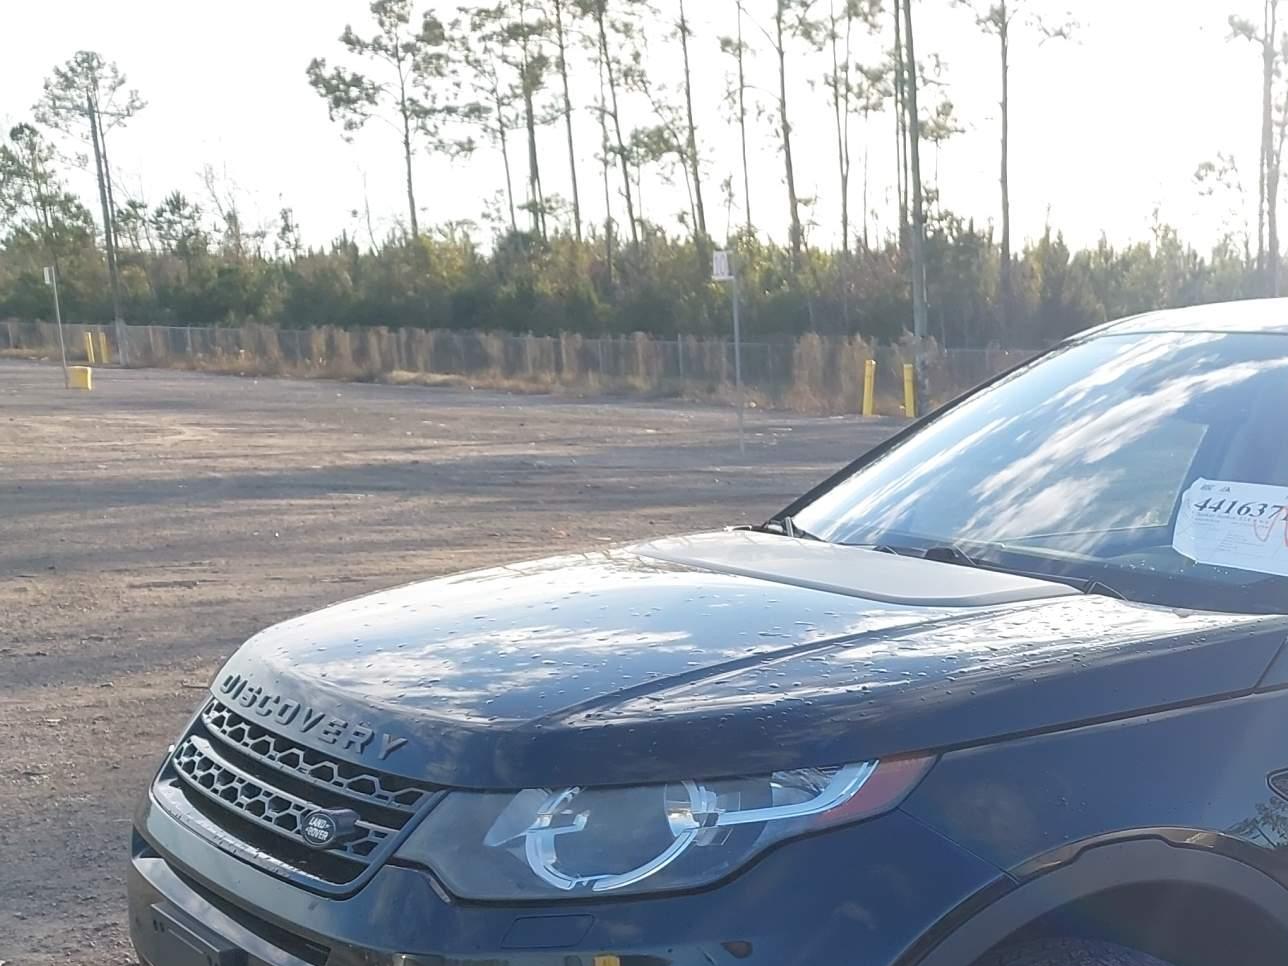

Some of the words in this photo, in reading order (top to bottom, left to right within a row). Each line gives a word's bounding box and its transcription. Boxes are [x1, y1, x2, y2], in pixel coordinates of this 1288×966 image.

[219, 674, 408, 761] DISCOVERY
[308, 816, 327, 829] LAND
[306, 826, 329, 840] ROVER
